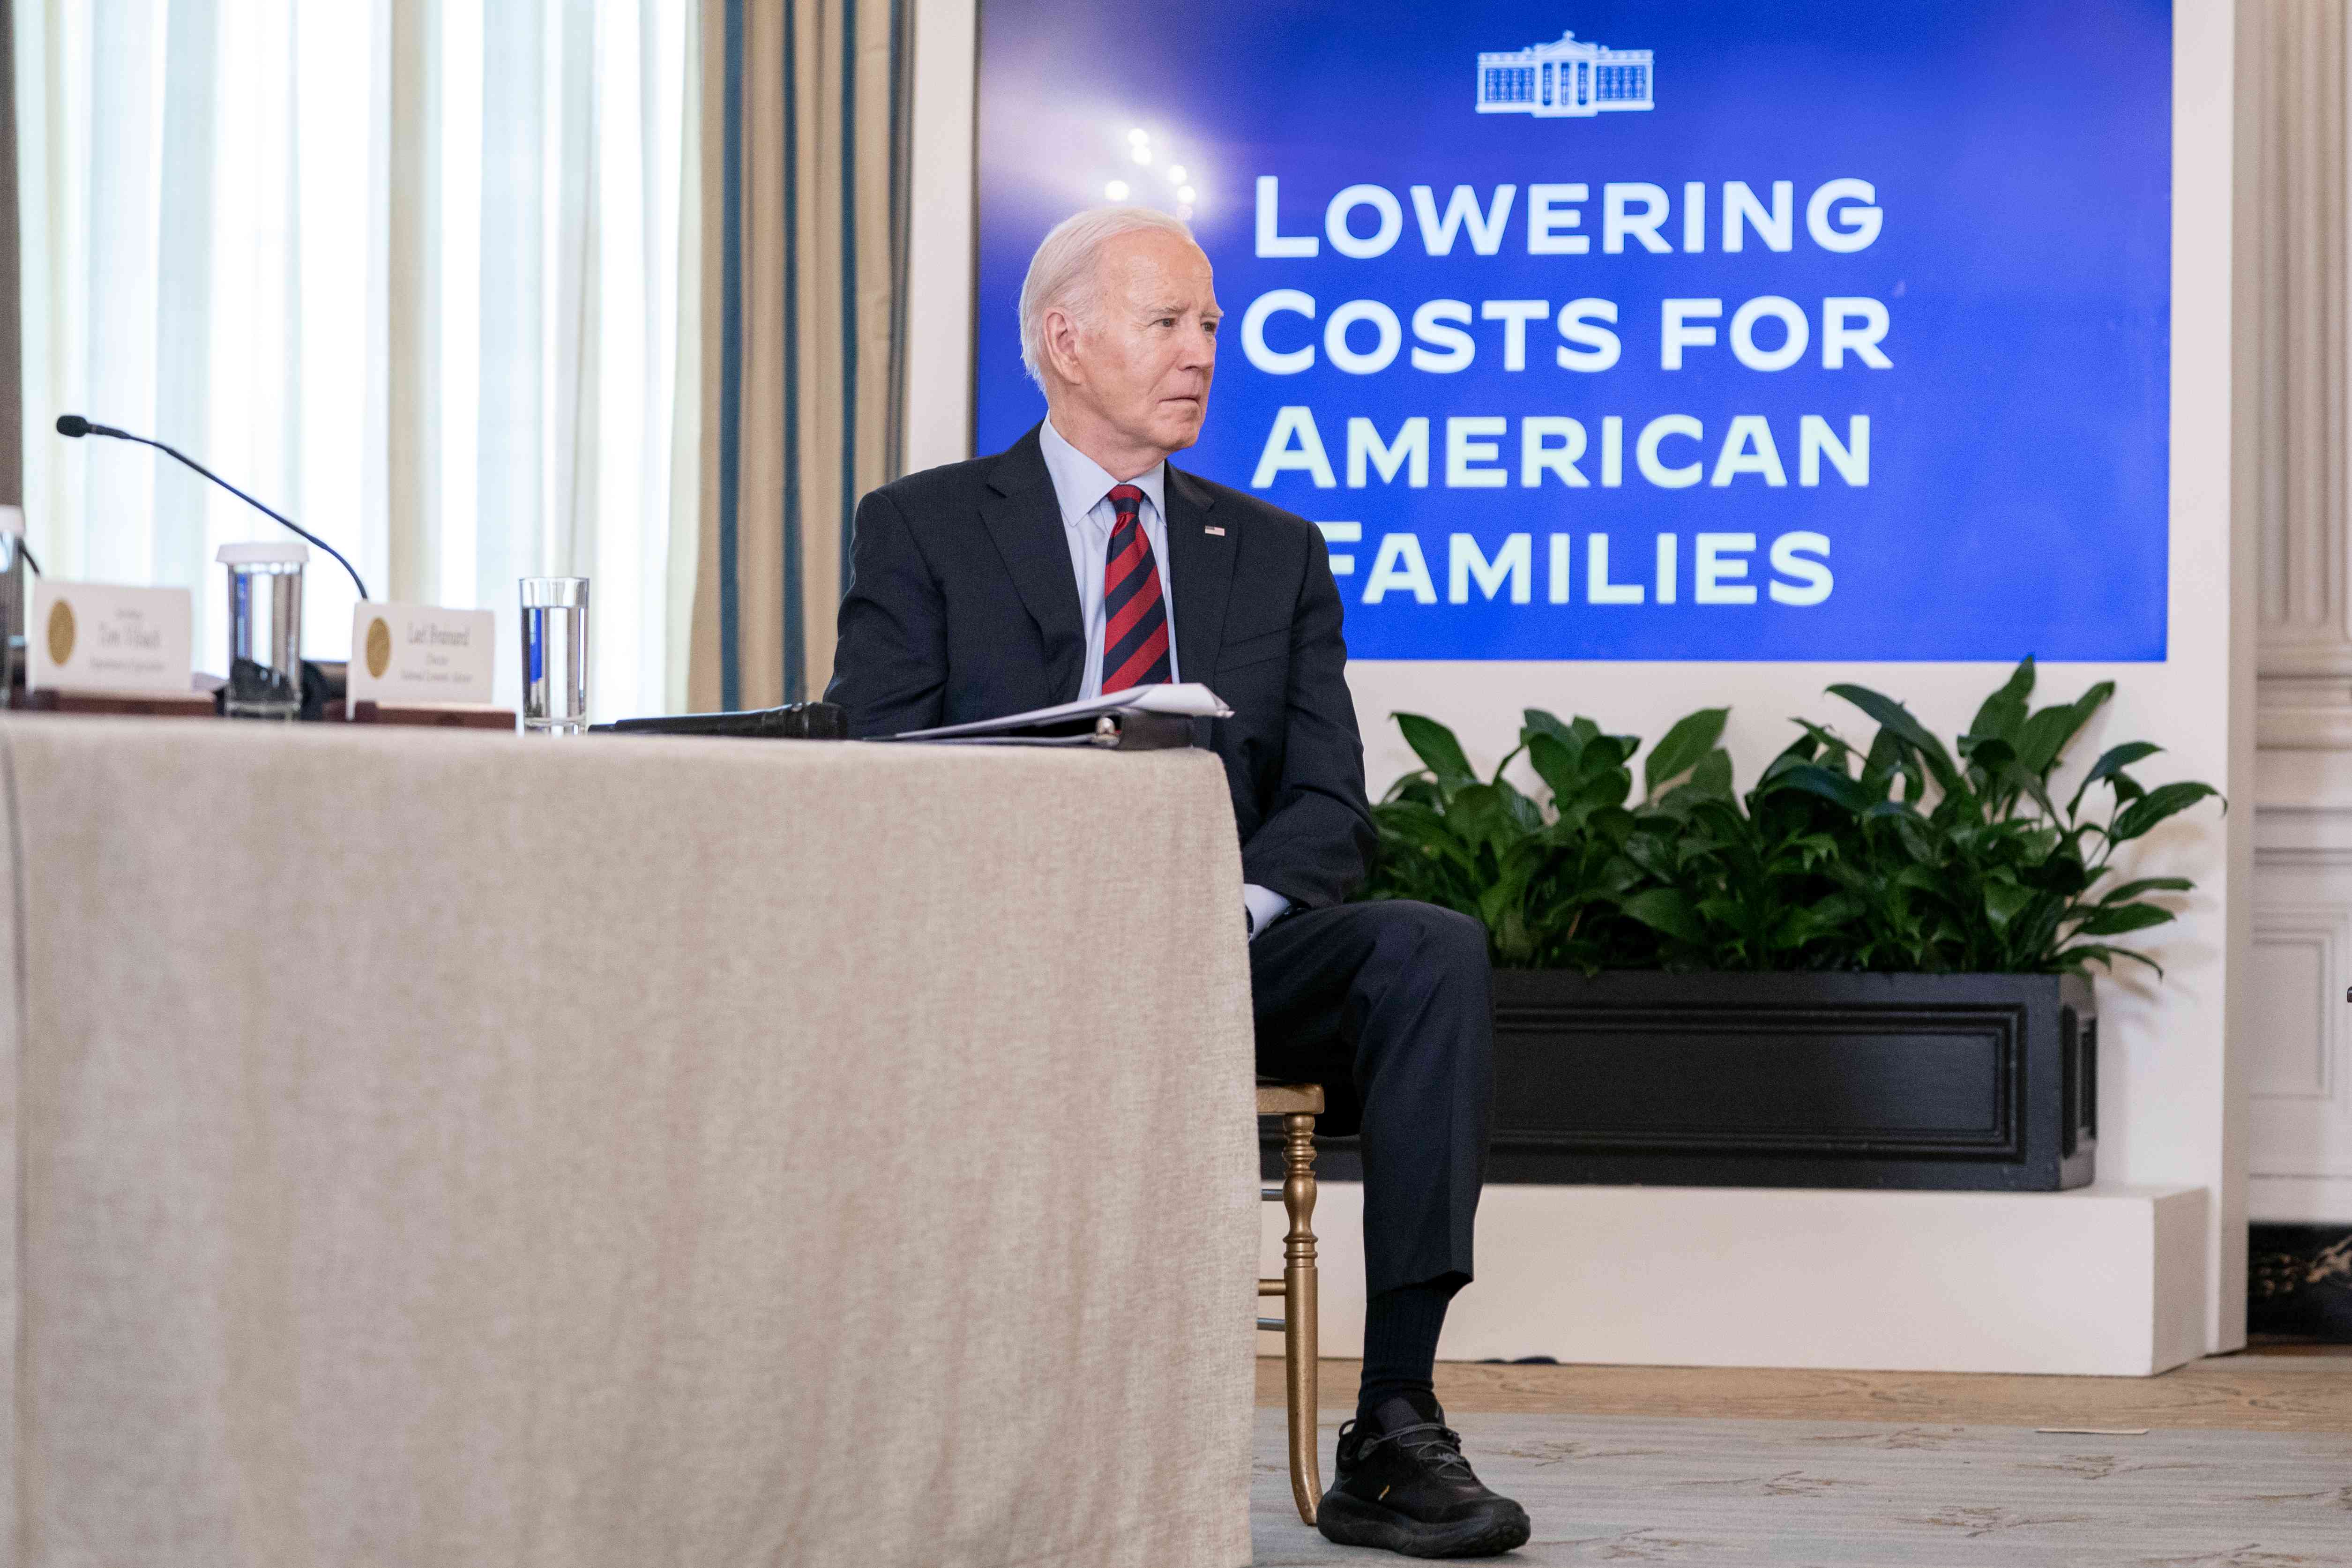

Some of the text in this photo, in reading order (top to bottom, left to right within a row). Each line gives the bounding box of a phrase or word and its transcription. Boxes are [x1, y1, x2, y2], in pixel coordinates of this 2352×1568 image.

[1254, 175, 1884, 259] LOWERING
[1240, 288, 1894, 375] COSTS FOR
[1251, 405, 1871, 489] AMERICAN
